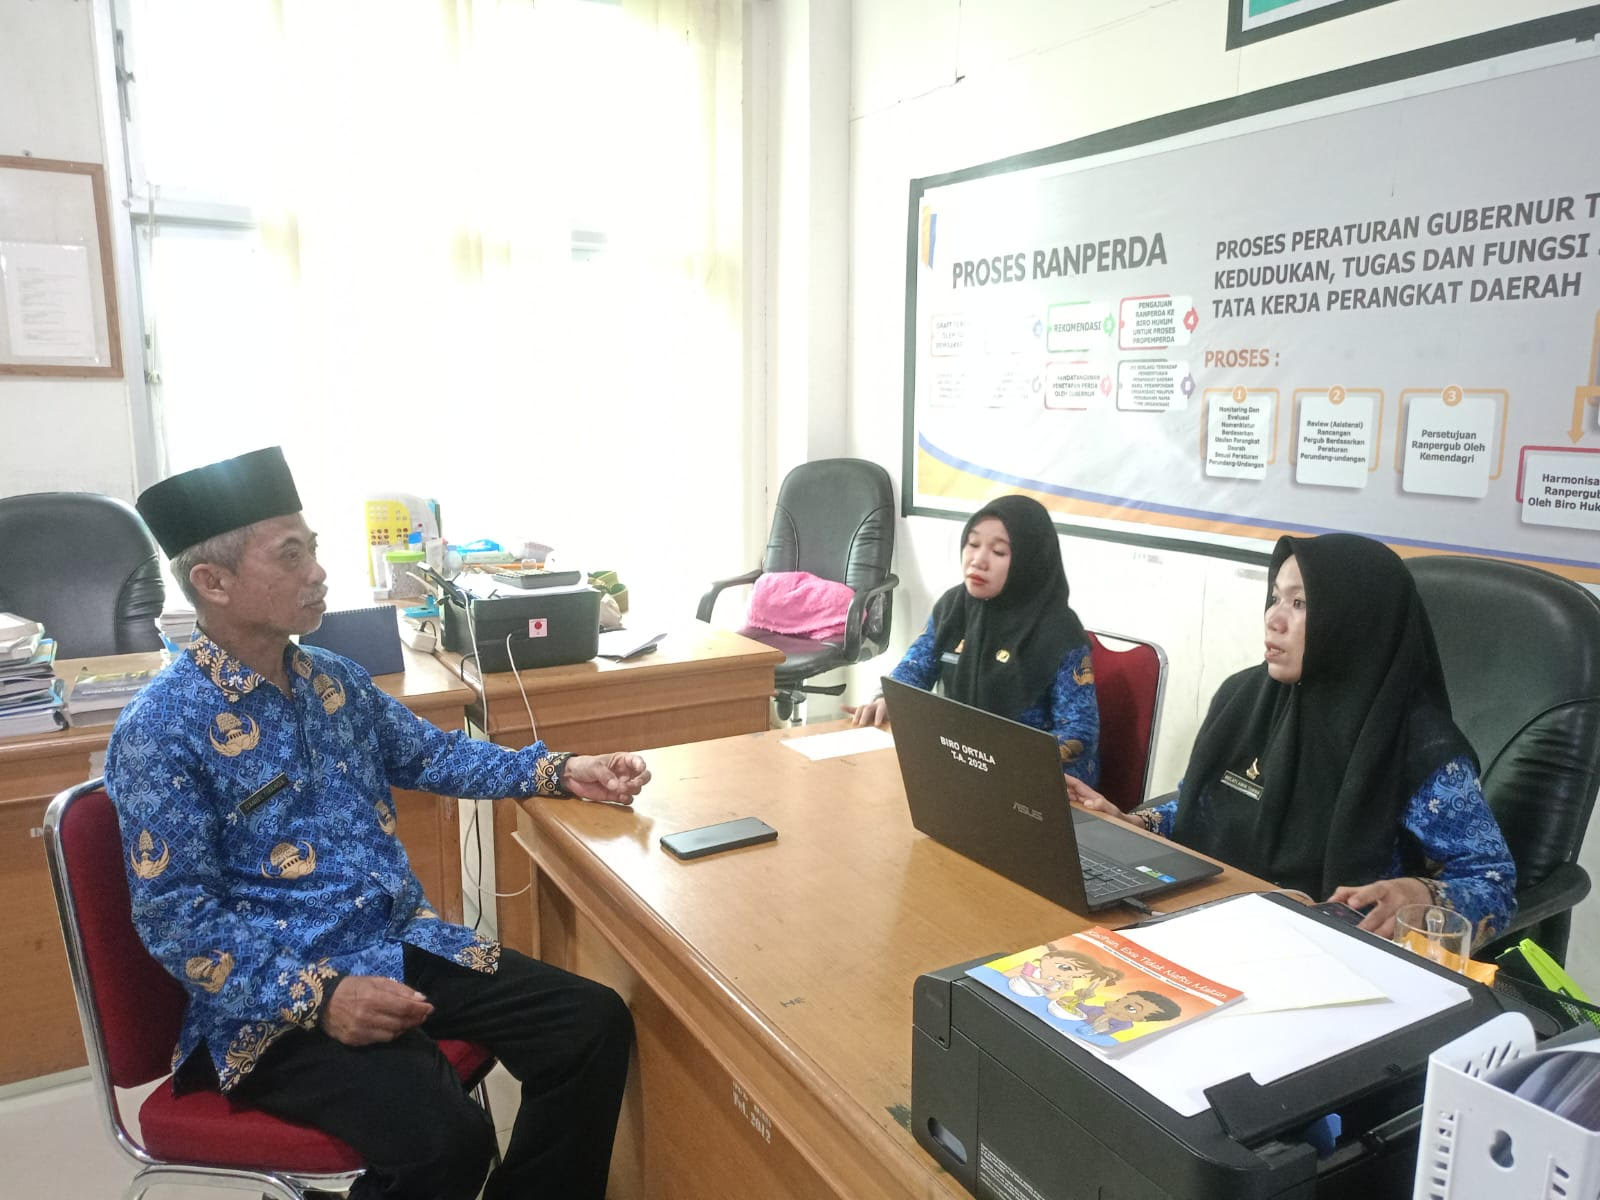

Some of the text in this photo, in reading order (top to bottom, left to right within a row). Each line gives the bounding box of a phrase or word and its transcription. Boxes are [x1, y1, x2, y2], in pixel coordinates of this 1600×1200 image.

[1216, 233, 1286, 260] PROSES
[1291, 216, 1420, 252] PERATURAN
[1427, 196, 1575, 236] GUBERNUR
[952, 232, 1168, 289] PROSES RANPERDA
[1214, 233, 1591, 289] KEDUDUKAN, TUGAS DAN FUNGSI
[1212, 272, 1582, 318] TATA KERJA PERANGKAT DAERAH
[1053, 321, 1102, 333] REKOMENDASI
[1204, 348, 1270, 368] PROSES
[1421, 429, 1477, 440] Persetujuan
[1318, 445, 1349, 453] Peraturan
[1411, 440, 1485, 452] Ranpergub Oleh
[1420, 452, 1475, 464] Kemendagri
[1542, 473, 1600, 486] Harmonisa
[1528, 497, 1551, 508] Oleh
[1554, 499, 1577, 510] Biro
[940, 735, 996, 766] BIRO ORTALA
[967, 757, 988, 772] 2025
[1012, 801, 1043, 822] ASUS
[1140, 956, 1165, 971] Tidak
[1164, 969, 1193, 985] Nafsu
[1192, 982, 1227, 999] Makan
